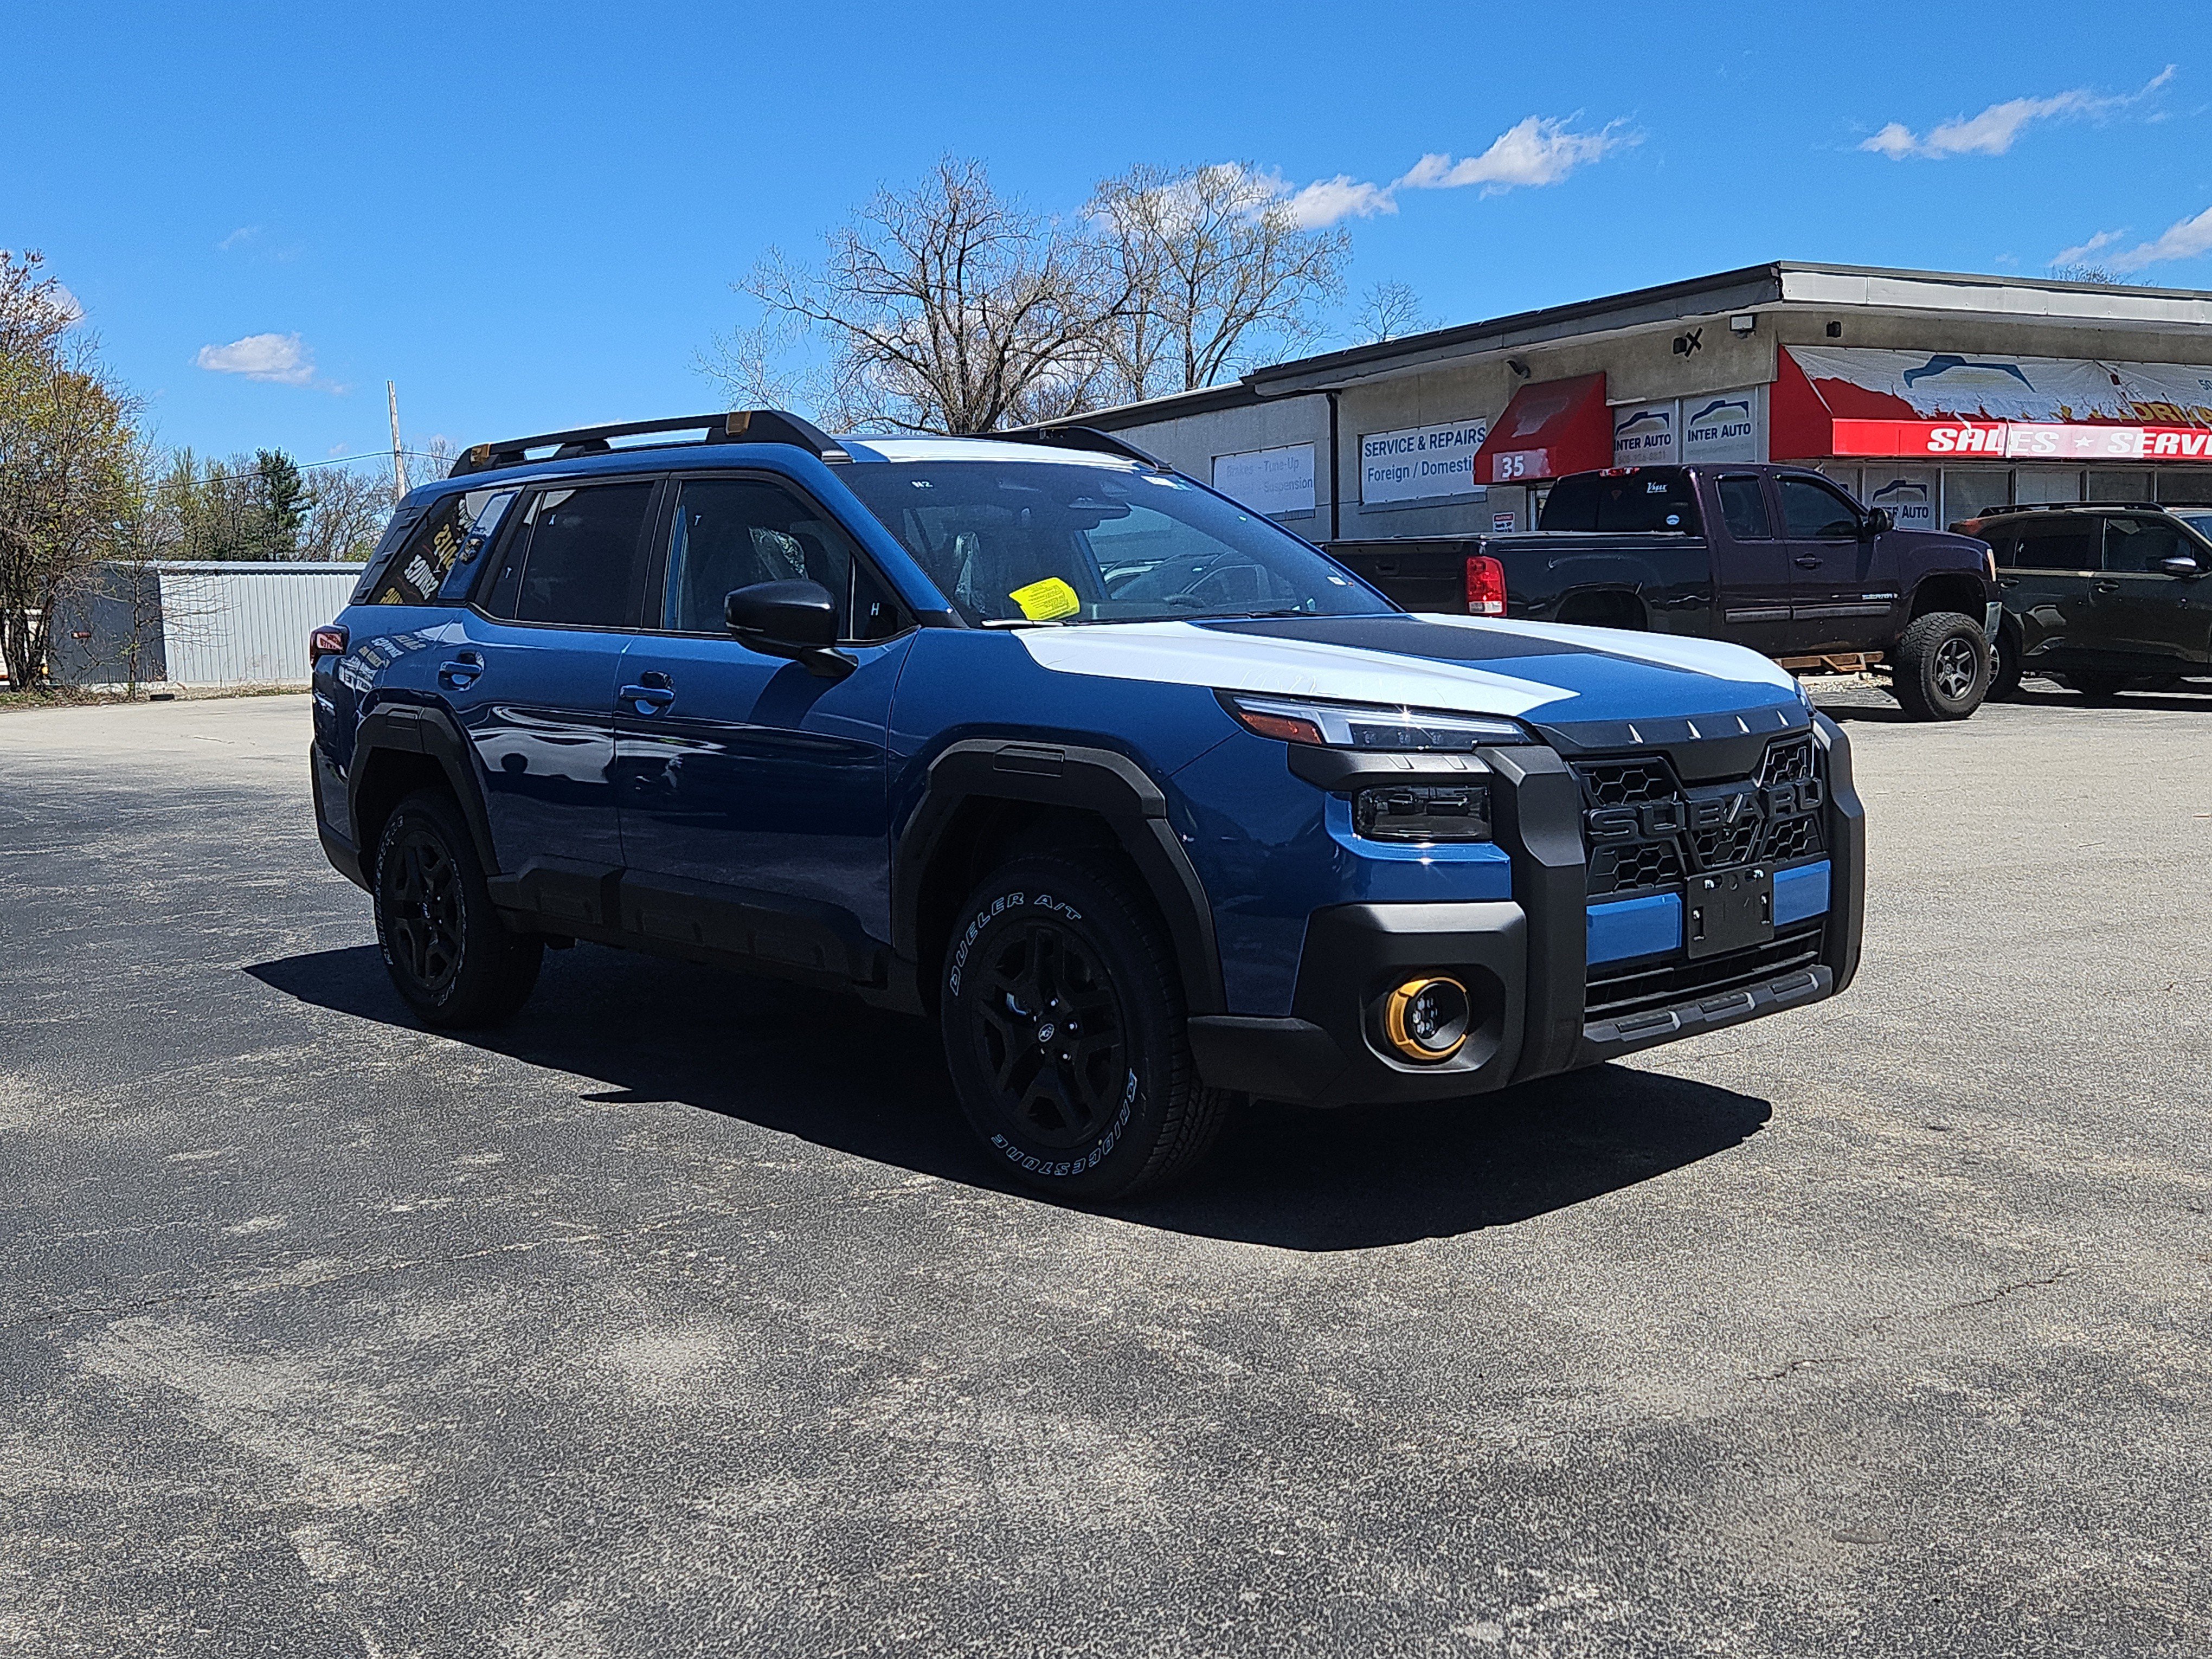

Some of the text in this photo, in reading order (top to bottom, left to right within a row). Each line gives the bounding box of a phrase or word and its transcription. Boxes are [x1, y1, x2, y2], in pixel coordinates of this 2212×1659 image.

[1365, 427, 1486, 458] SERVICE & REPAIRS
[1643, 434, 1671, 448] AUTO
[1688, 423, 1751, 442] INTER AUTO
[1927, 428, 2059, 453] SALES
[1368, 465, 1410, 483] Foreign
[1422, 455, 1472, 475] Domesti
[1502, 455, 1524, 478] 35
[1901, 505, 1928, 518] AUTO
[1588, 777, 1823, 841] SUBARU
[950, 892, 1082, 996] DUELER A/T
[991, 1067, 1137, 1175] BRIDGESTONE
